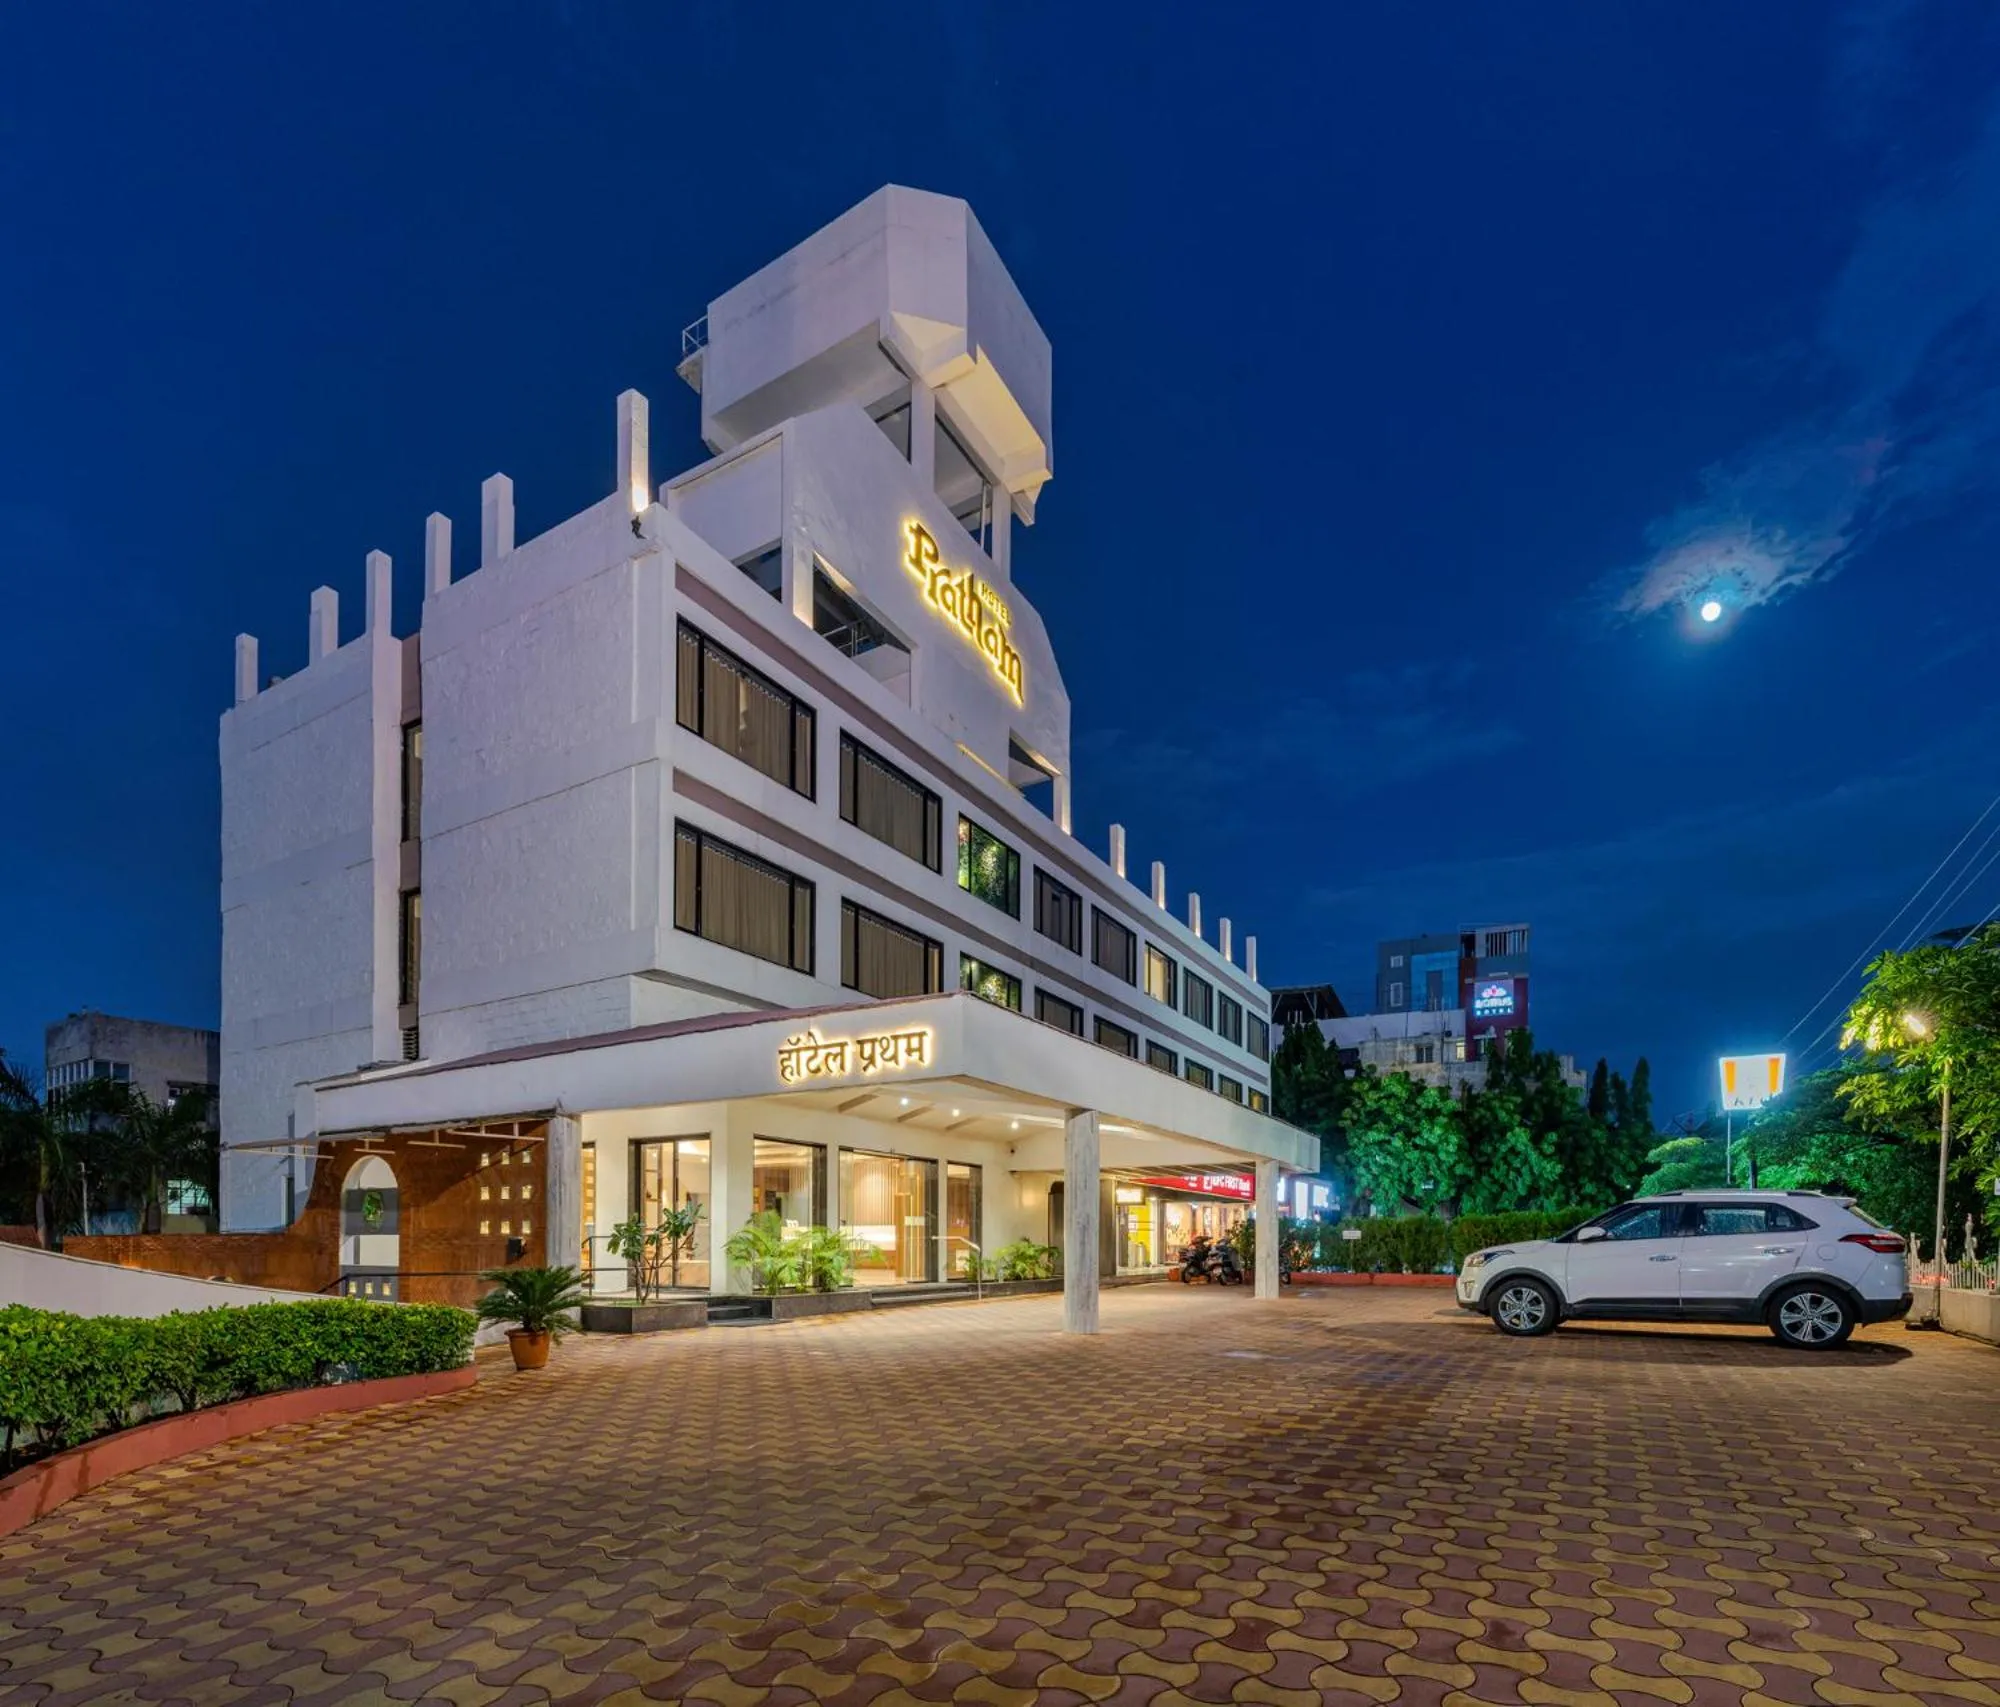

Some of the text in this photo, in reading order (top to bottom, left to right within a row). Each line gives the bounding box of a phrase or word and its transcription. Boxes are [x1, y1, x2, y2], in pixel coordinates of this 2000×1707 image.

[907, 522, 1025, 705] Pratham
[981, 582, 1012, 627] HOTEL
[778, 1031, 928, 1082] हॉटेल प्रथम
